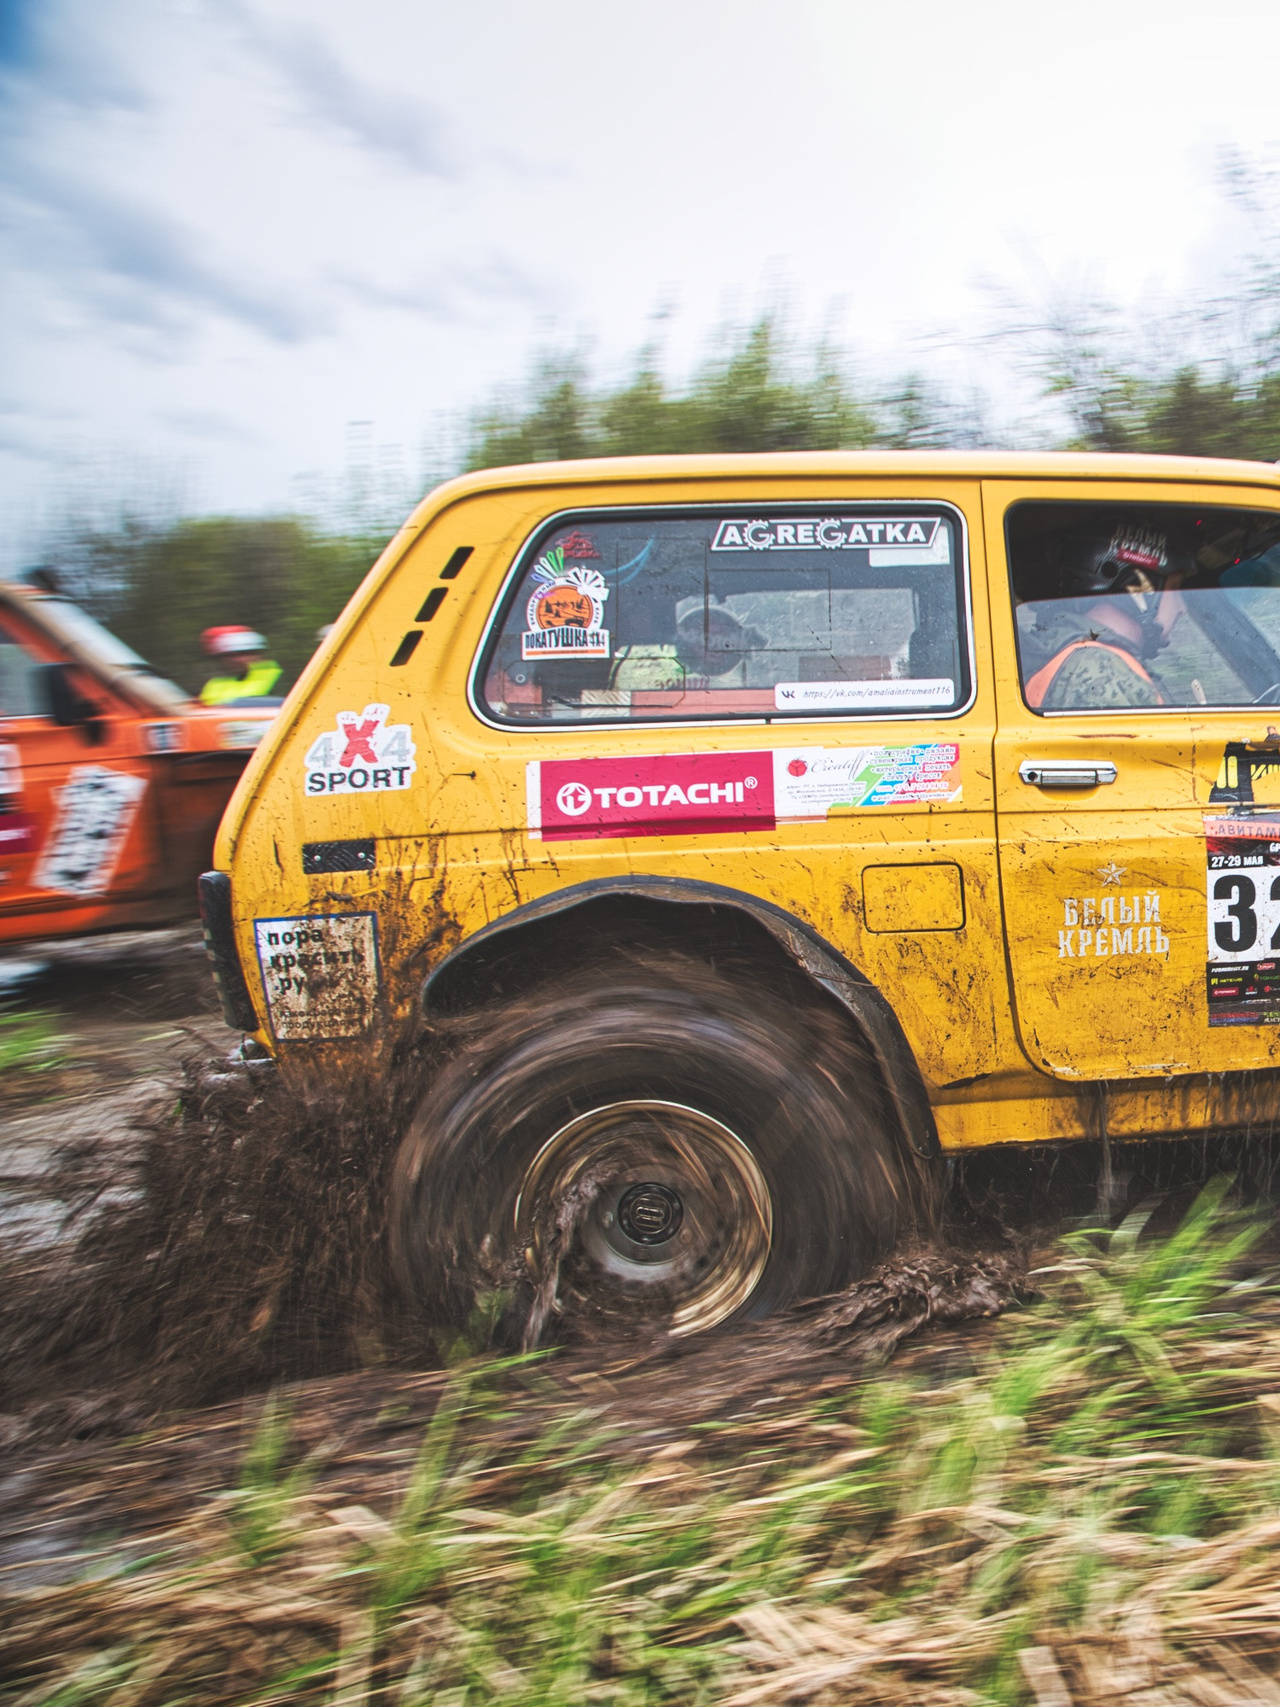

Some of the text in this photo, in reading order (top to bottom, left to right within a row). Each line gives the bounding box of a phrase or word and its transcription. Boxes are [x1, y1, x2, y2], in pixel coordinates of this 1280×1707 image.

[722, 519, 926, 549] AGREGATKA
[525, 628, 588, 649] ПОКАТУШКА
[308, 766, 411, 792] SPORT
[1211, 855, 1263, 868] 27-29 МАЯ
[1063, 890, 1161, 926] БЕЛЫЙ
[267, 929, 323, 948] пора
[1058, 926, 1170, 957] КРЕМЛЬ
